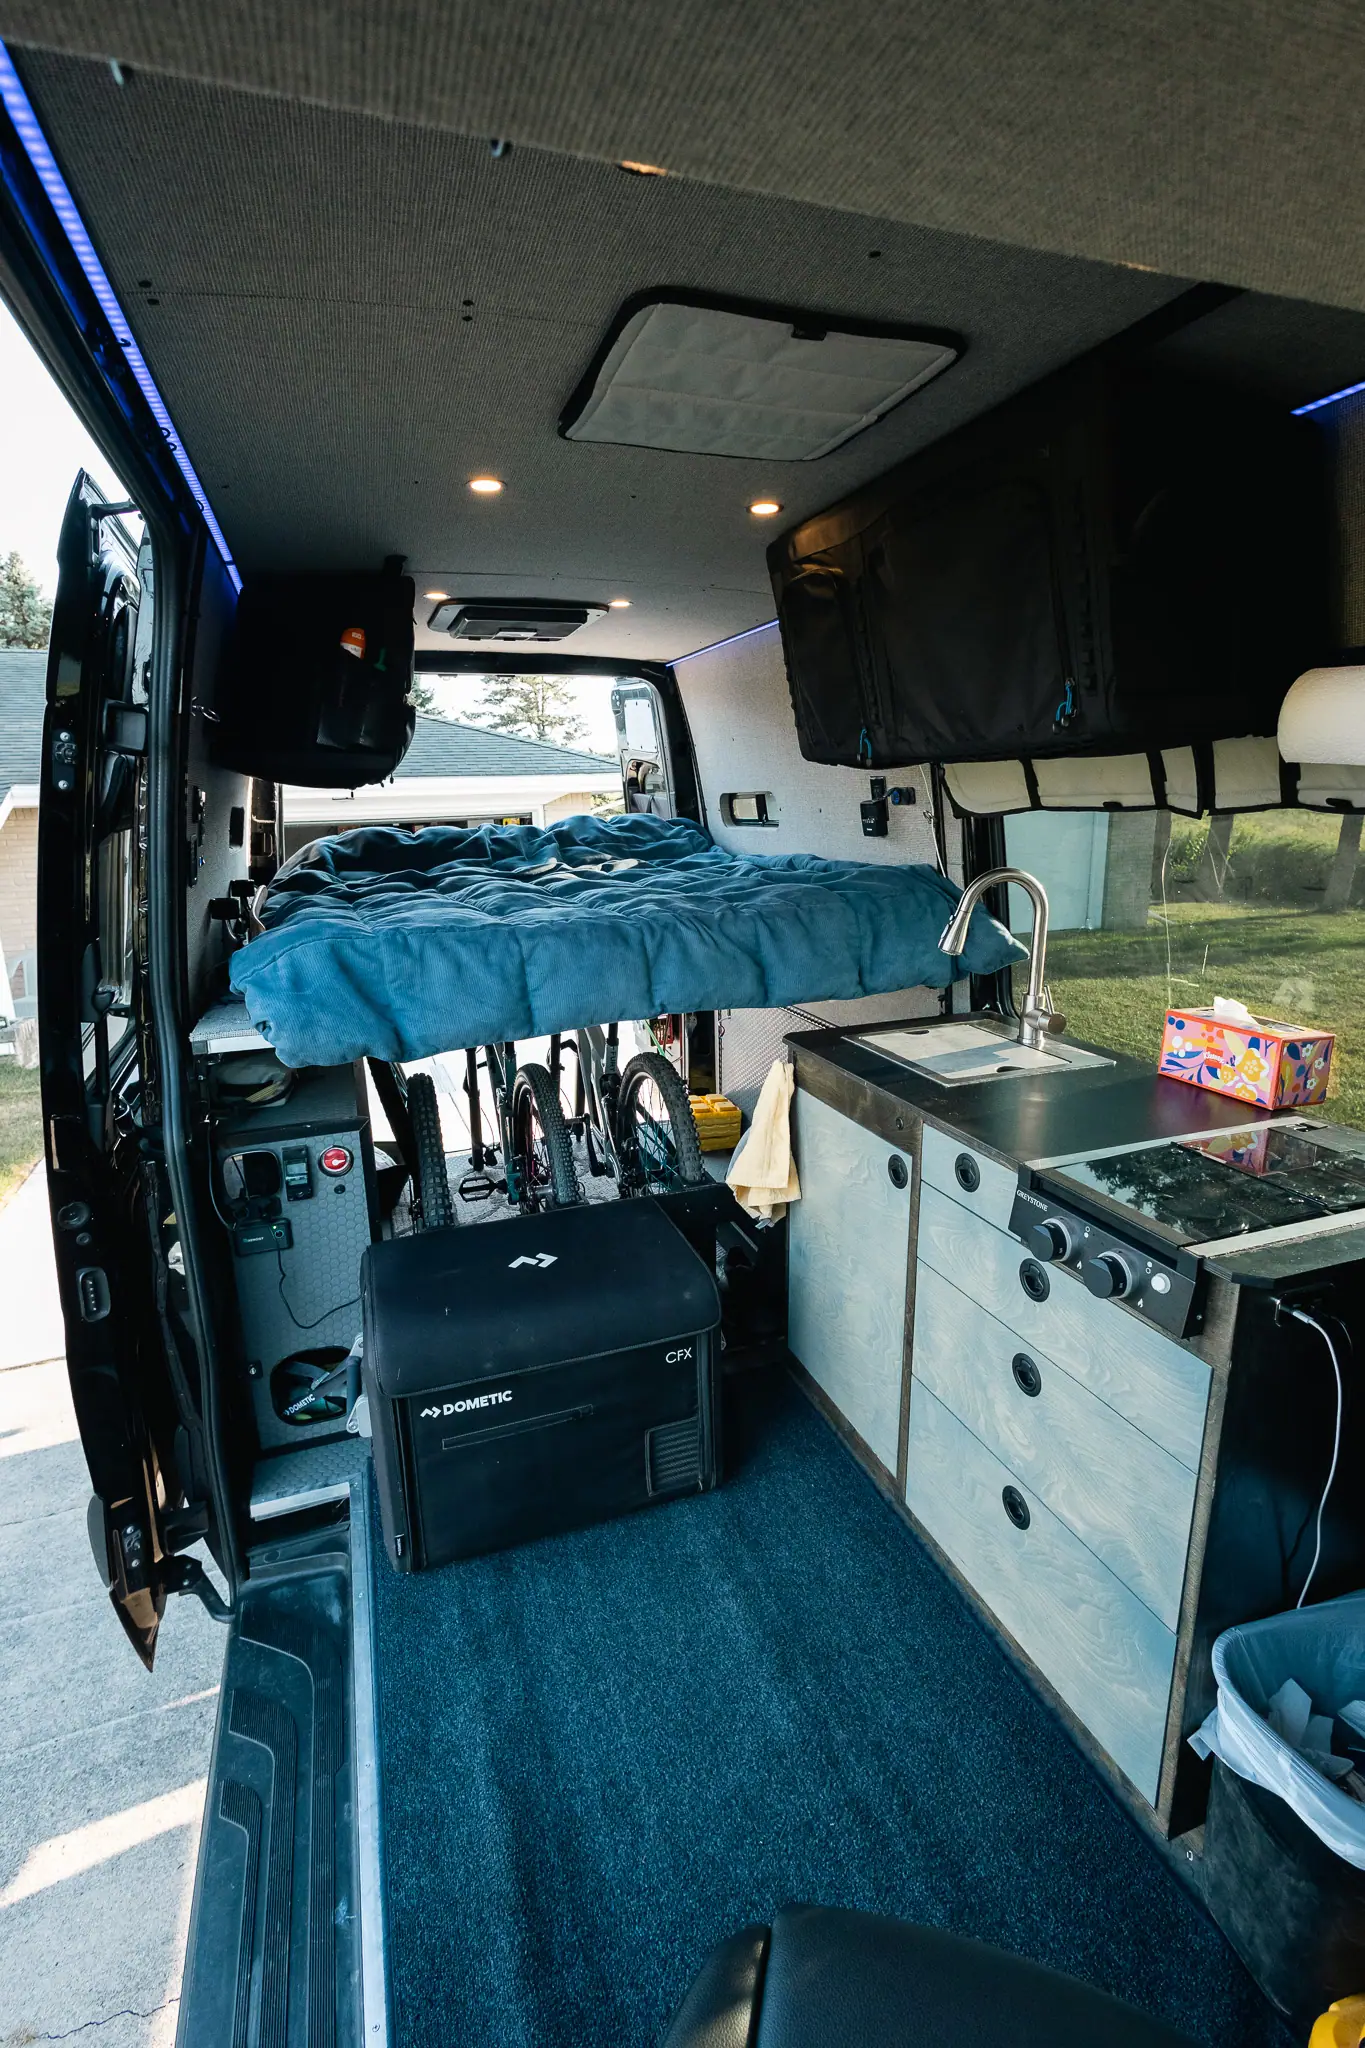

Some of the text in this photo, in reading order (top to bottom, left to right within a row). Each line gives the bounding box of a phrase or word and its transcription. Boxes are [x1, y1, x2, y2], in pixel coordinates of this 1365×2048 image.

[1016, 1189, 1048, 1212] GREYSTONE
[665, 1347, 692, 1363] CFX
[288, 1393, 316, 1414] DOMETIC
[442, 1390, 513, 1416] DOMETIC
